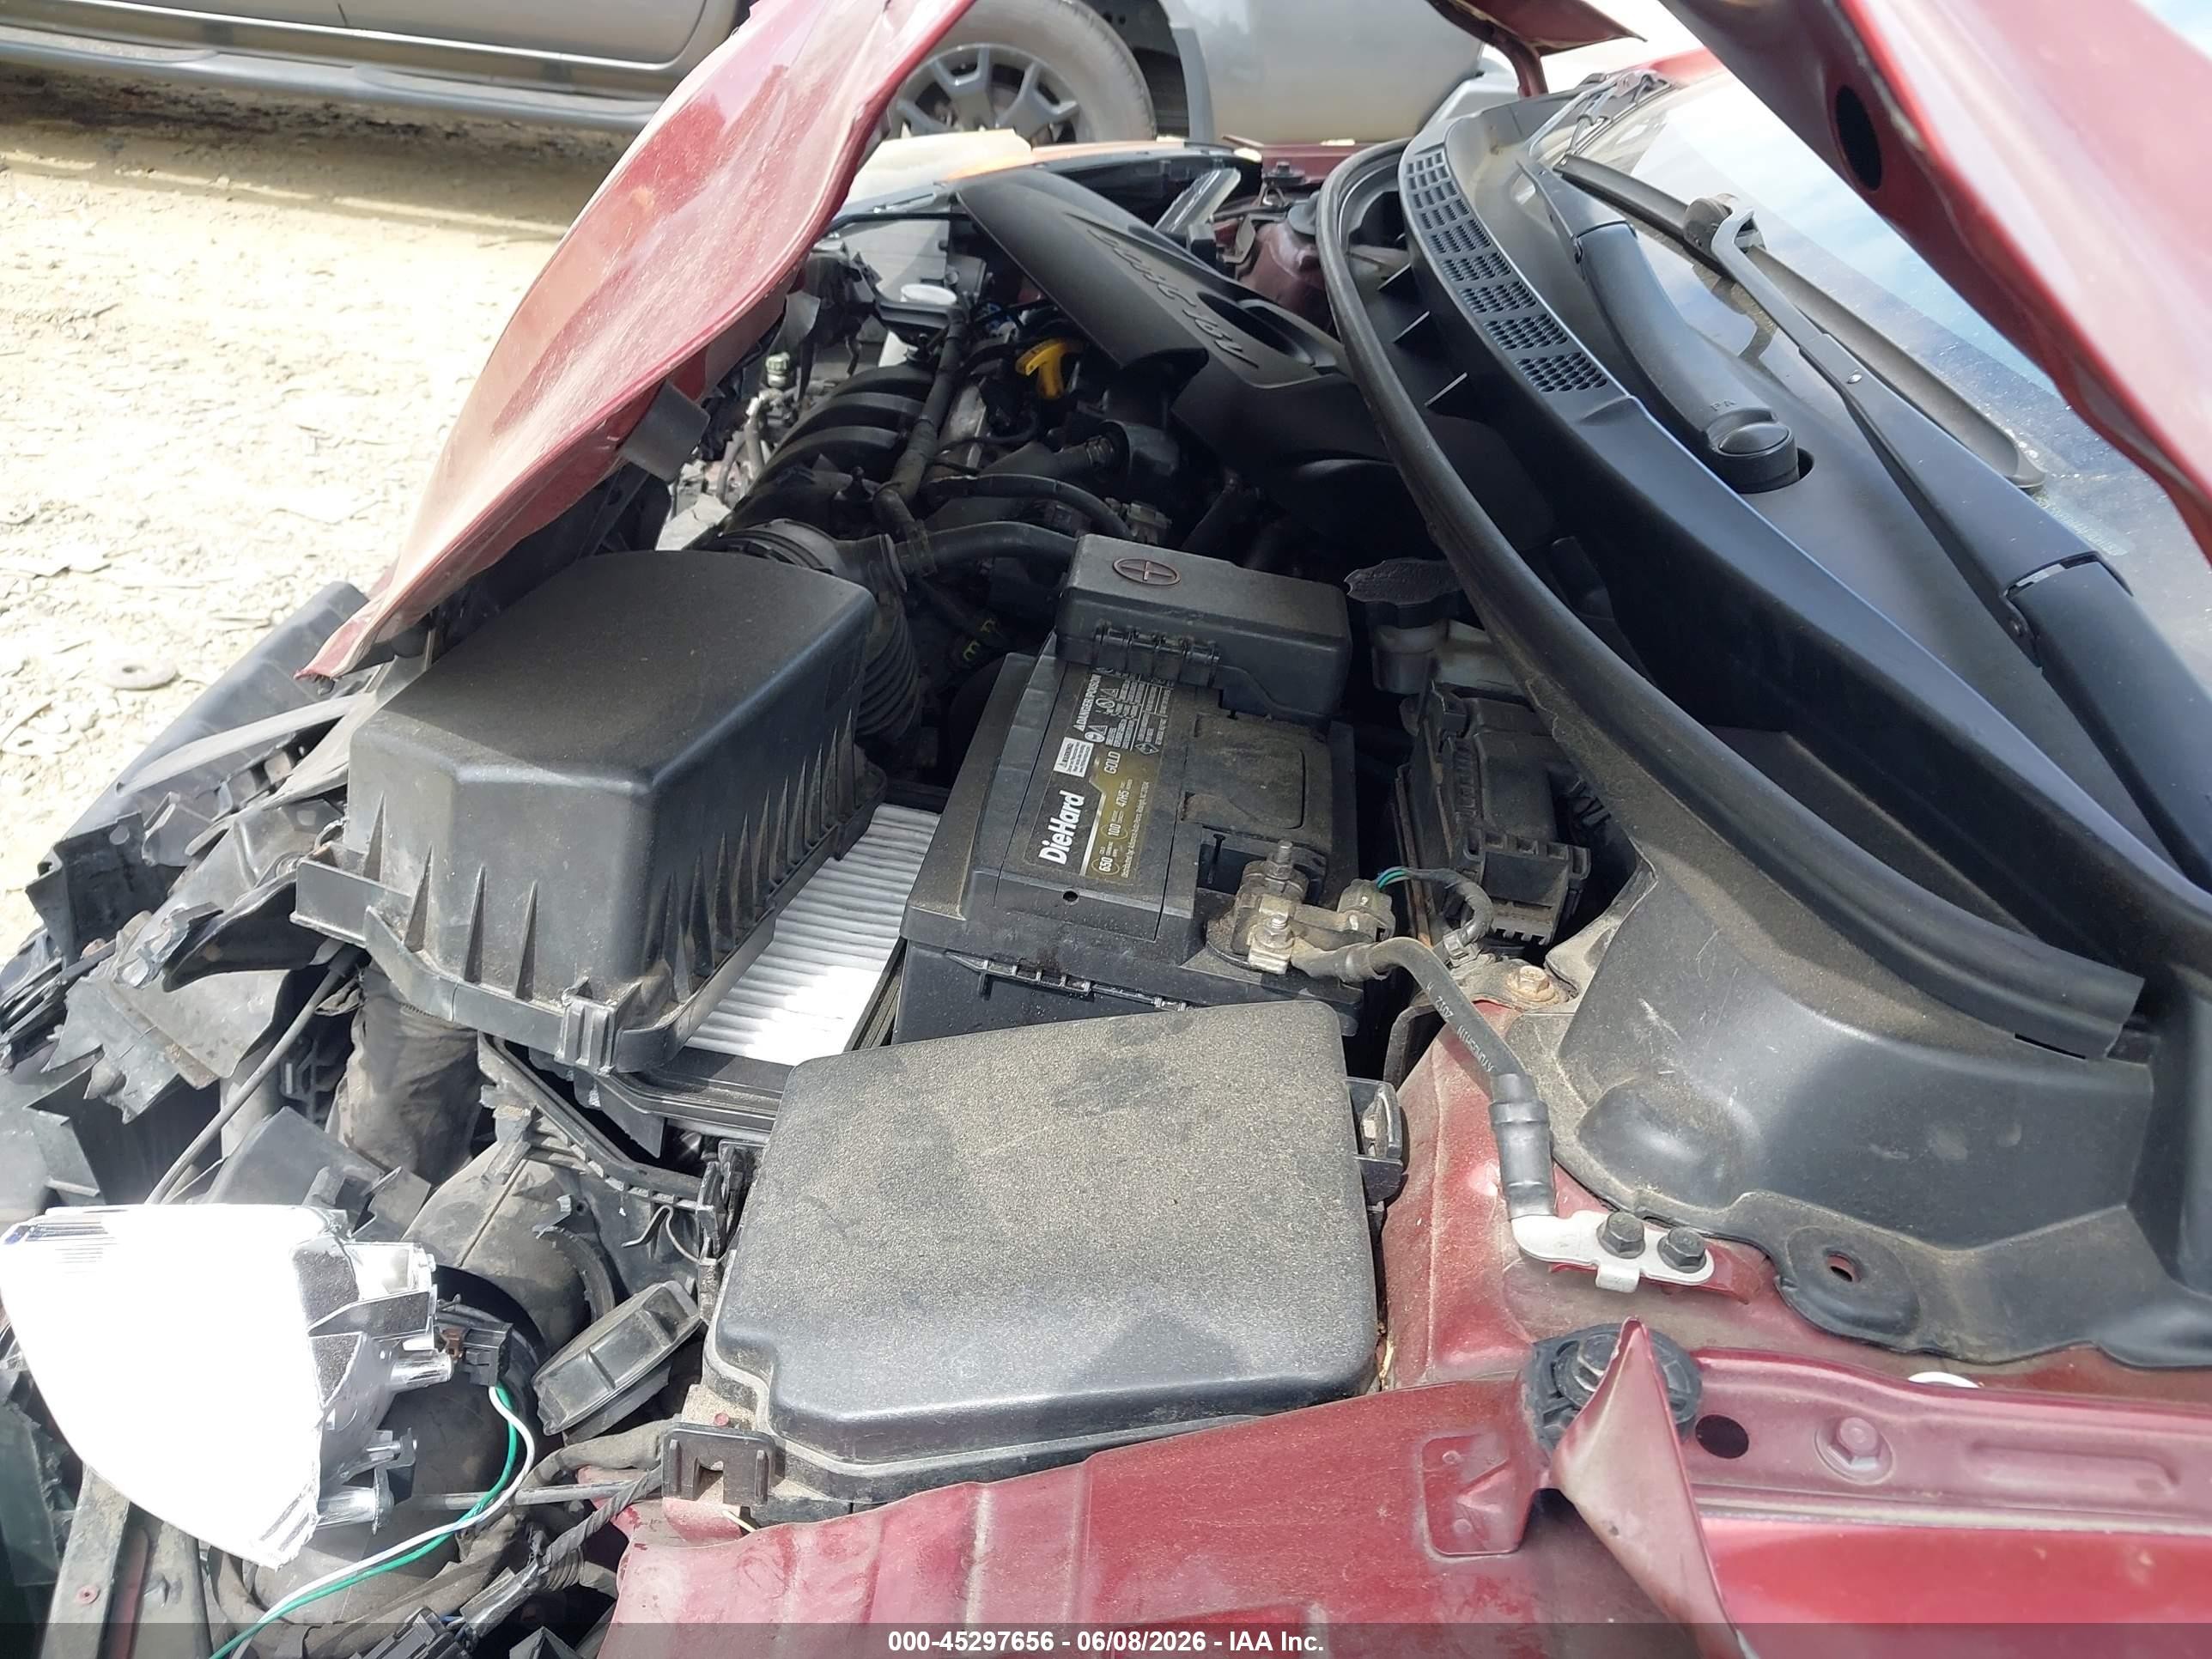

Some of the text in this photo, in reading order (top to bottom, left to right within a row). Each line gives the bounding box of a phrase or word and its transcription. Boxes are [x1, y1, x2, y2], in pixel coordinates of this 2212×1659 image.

[1104, 751, 1121, 775] GOLD
[1038, 790, 1085, 865] DieHard
[1108, 823, 1121, 836] 100
[1099, 857, 1113, 872] 650
